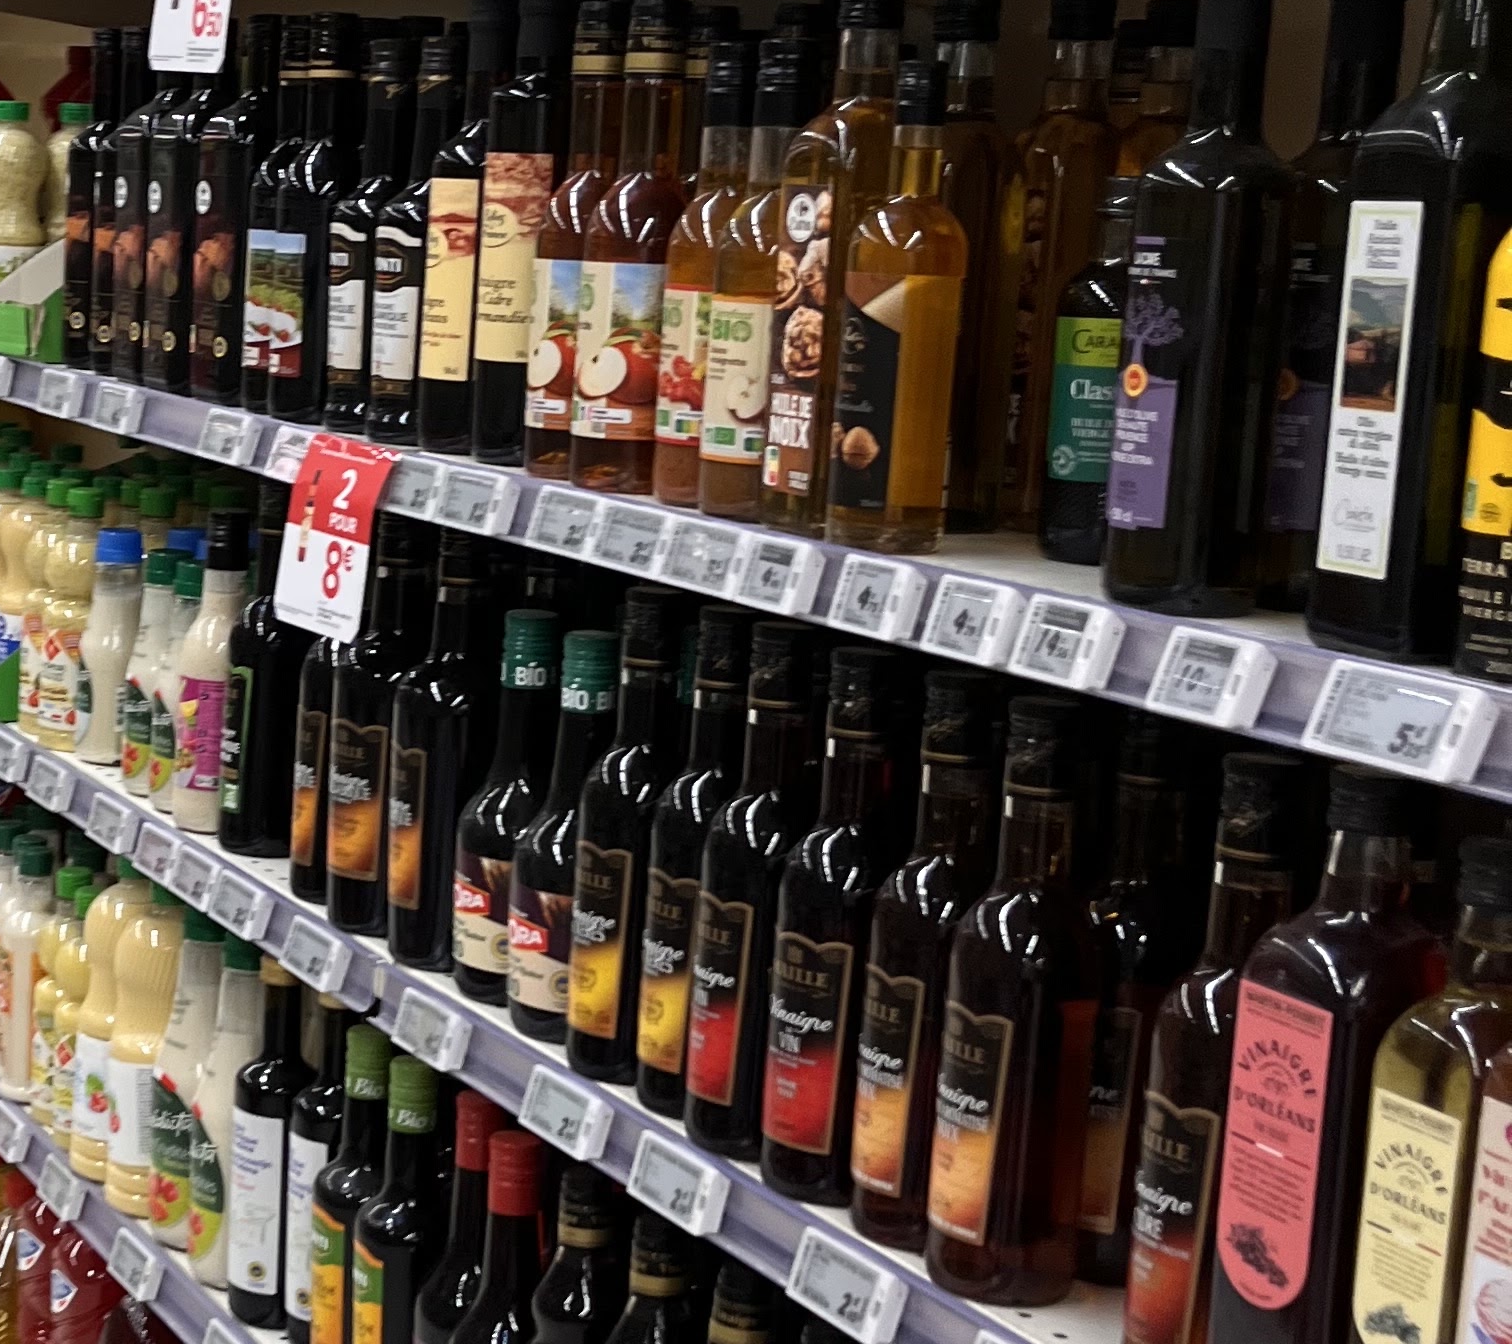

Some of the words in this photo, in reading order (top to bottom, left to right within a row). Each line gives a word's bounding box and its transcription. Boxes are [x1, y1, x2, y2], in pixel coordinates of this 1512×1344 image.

[1071, 329, 1120, 354] CARA
[768, 414, 811, 449] NOIX
[333, 468, 357, 509] 2
[328, 512, 358, 534] POUR
[515, 666, 547, 686] BIO
[770, 994, 834, 1034] Vinaigre
